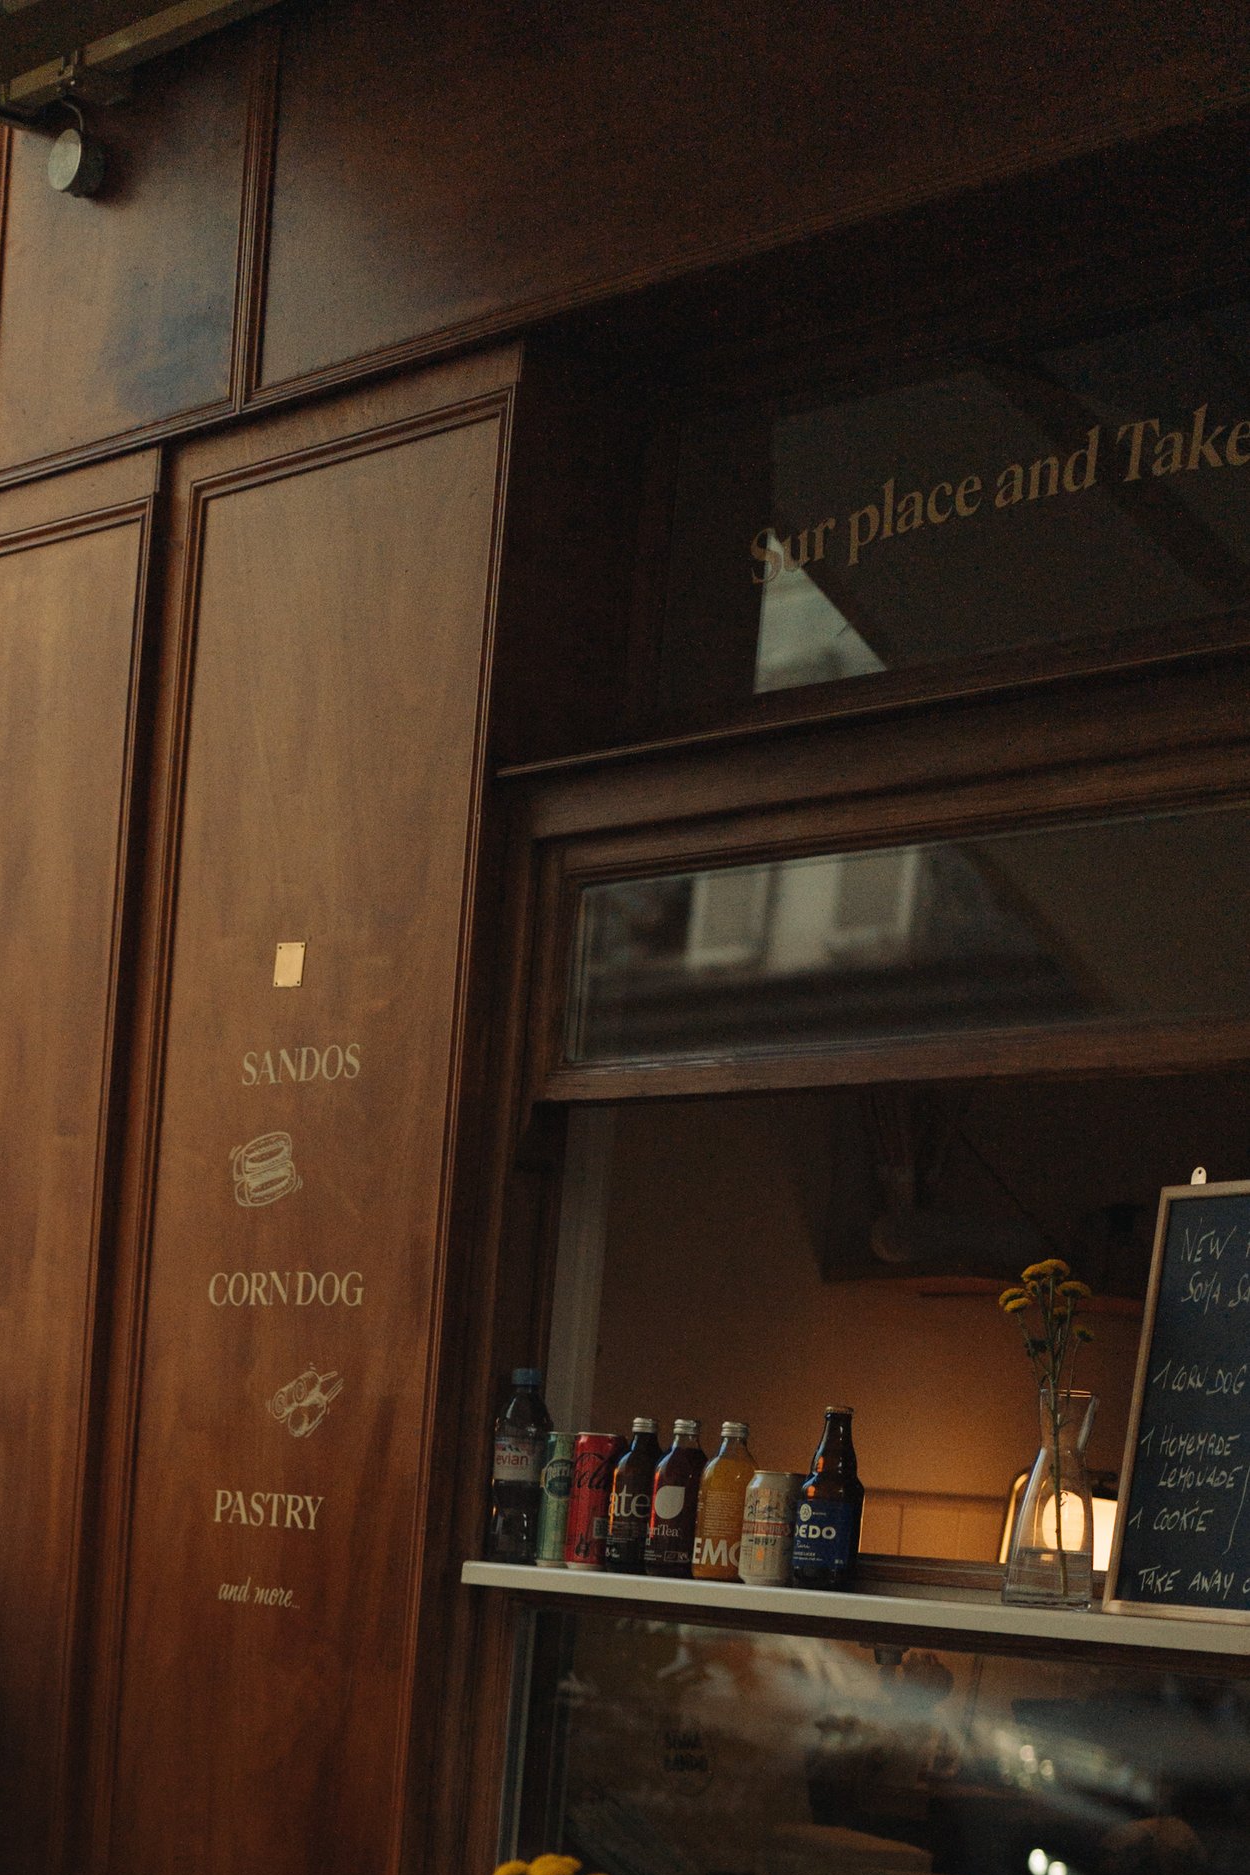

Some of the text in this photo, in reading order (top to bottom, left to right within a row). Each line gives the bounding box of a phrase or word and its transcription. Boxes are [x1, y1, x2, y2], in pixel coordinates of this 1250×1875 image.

[750, 403, 1250, 584] Sur place and Take
[242, 1043, 361, 1087] SANDOS
[1181, 1217, 1237, 1263] NEW
[209, 1271, 363, 1307] CORN DOG
[1152, 1360, 1246, 1395] 1 CORN DOG
[1141, 1426, 1155, 1456] 1
[496, 1453, 529, 1467] evian
[214, 1489, 325, 1530] PASTRY
[1129, 1507, 1143, 1529] 1
[218, 1576, 251, 1603] and
[1139, 1565, 1181, 1594] TAKE
[1188, 1569, 1234, 1600] AWAY
